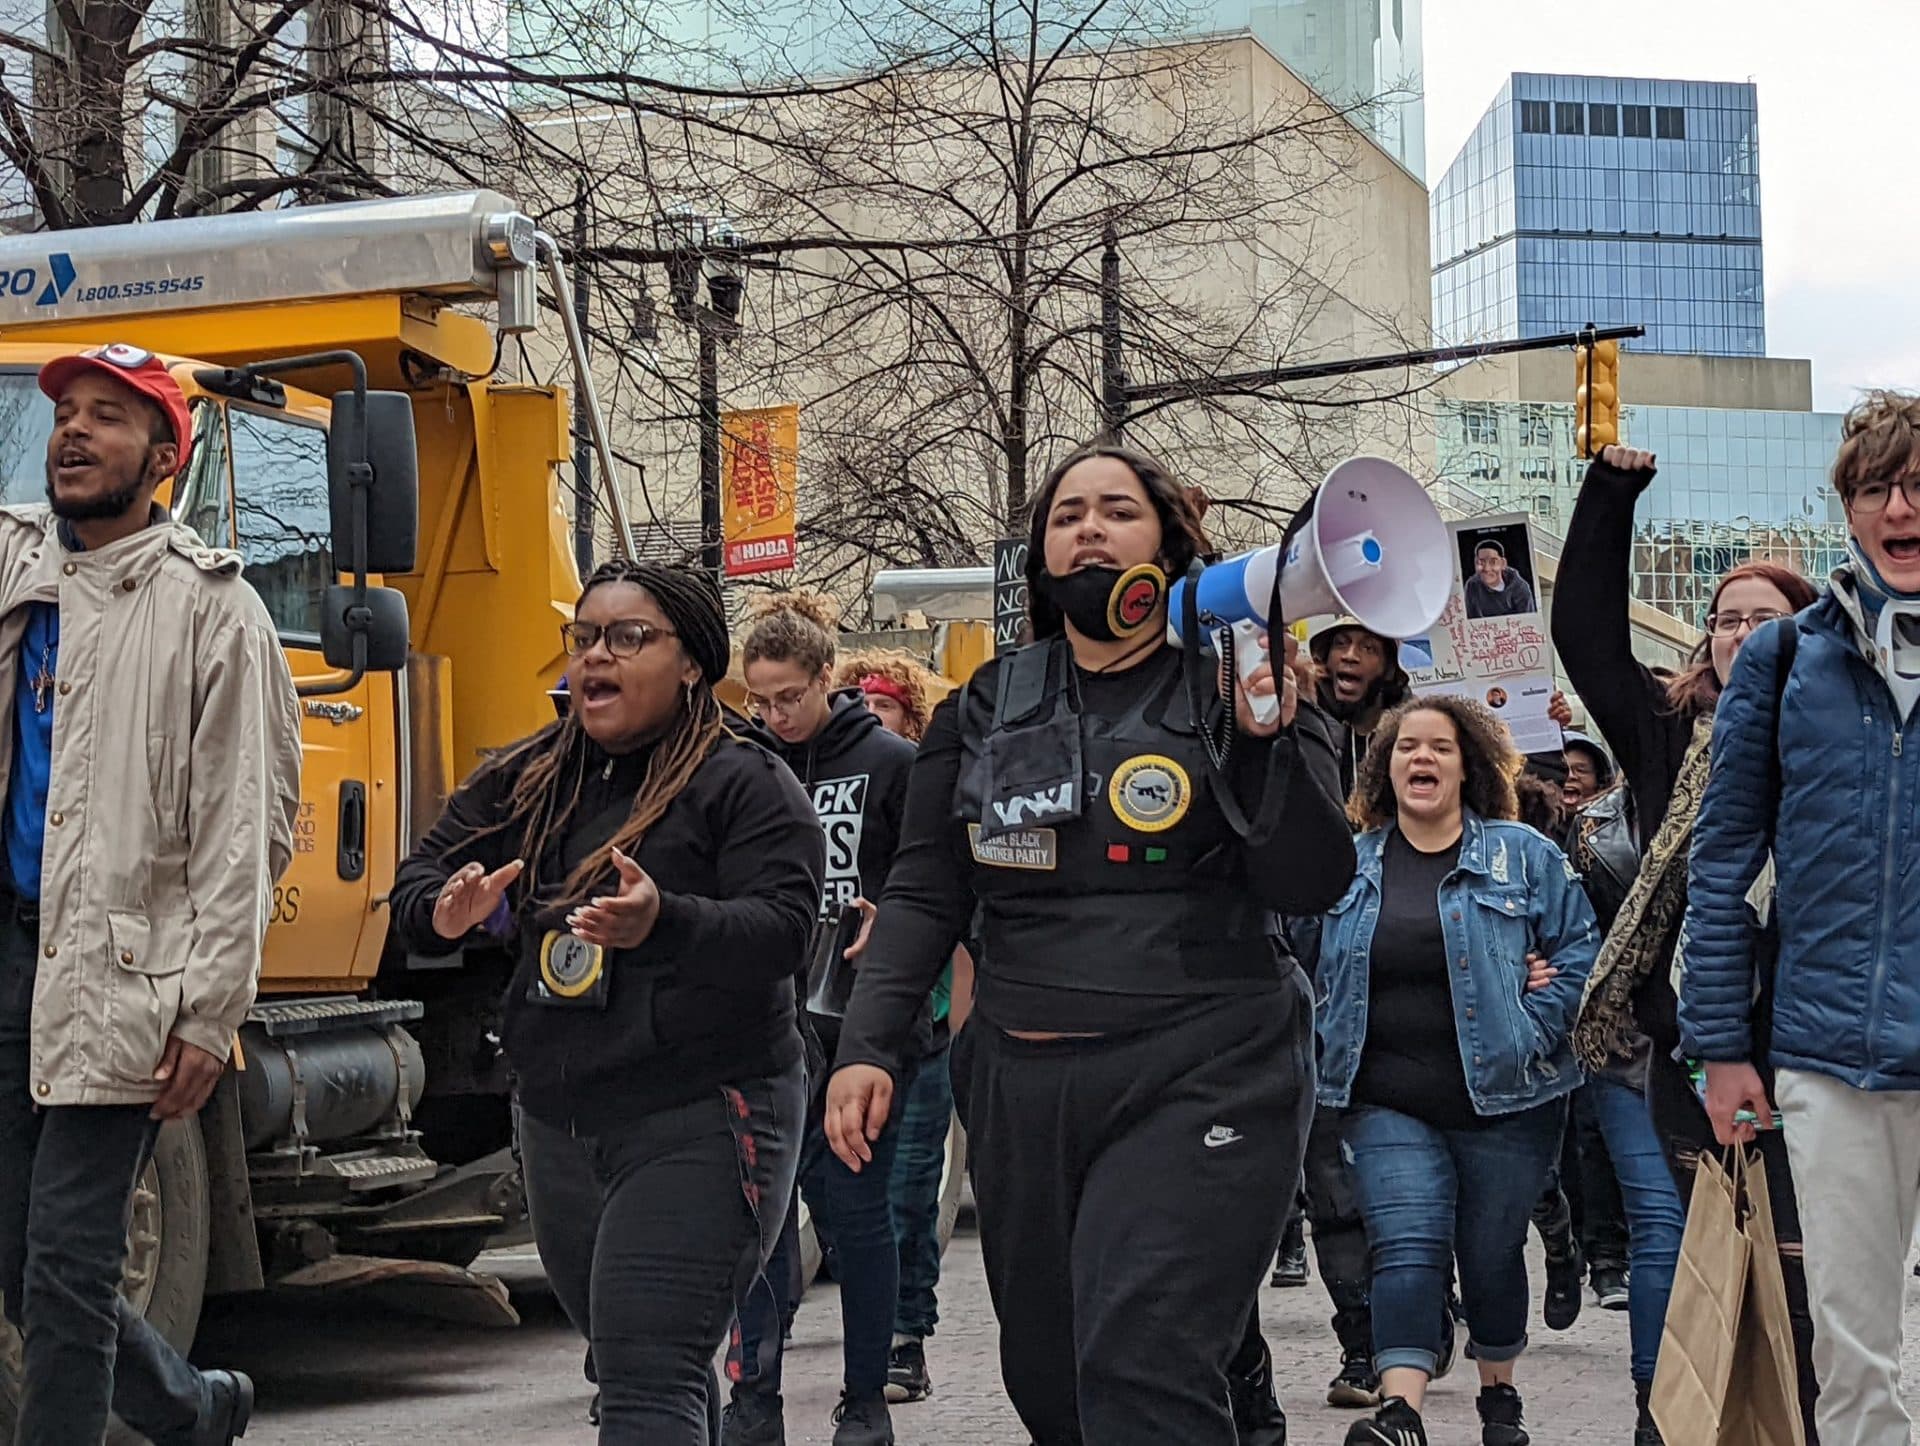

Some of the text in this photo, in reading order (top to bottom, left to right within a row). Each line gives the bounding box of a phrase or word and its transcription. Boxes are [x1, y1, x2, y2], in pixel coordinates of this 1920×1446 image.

[76, 276, 204, 302] 1.800.535.9545
[752, 421, 776, 518] DISTRCT
[742, 538, 788, 559] HDBA
[1009, 832, 1041, 849] BLACK
[974, 844, 1049, 865] PANTHER PARTY
